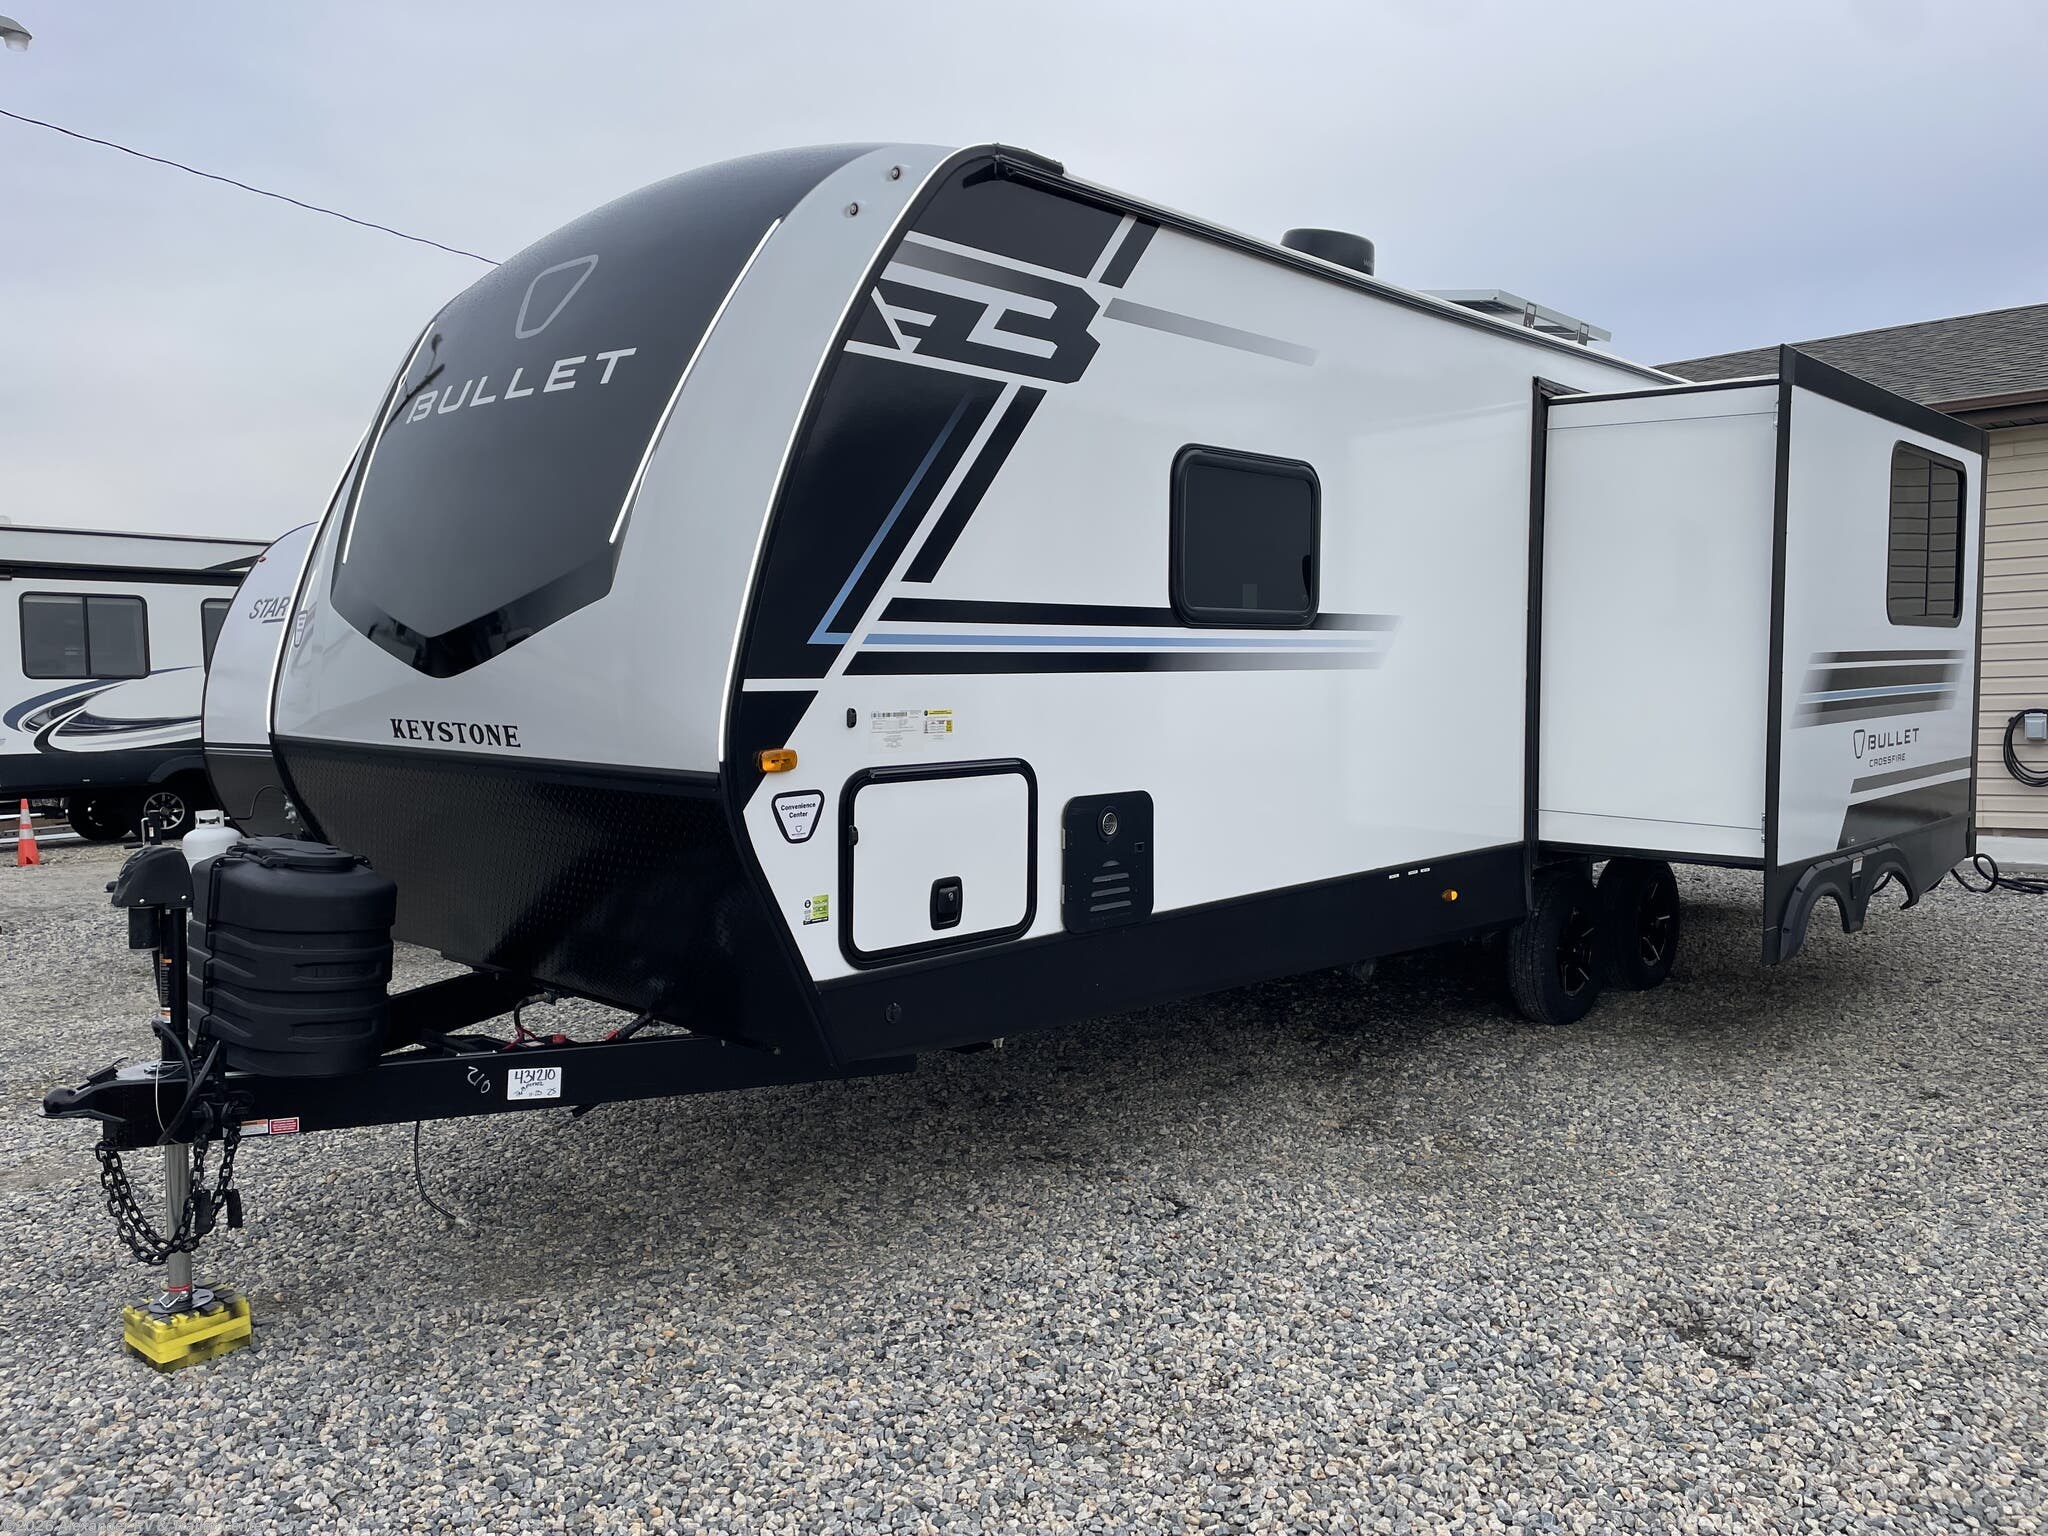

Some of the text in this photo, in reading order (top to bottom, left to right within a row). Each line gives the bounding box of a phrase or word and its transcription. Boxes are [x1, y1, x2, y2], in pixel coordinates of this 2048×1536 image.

[406, 347, 637, 425] BULLET
[390, 718, 521, 748] KEYSTONE
[1868, 727, 1920, 751] BULLET
[1869, 752, 1906, 768] CROSSFIRE
[781, 802, 816, 811] Convenience
[467, 1065, 491, 1094] 210
[514, 1068, 556, 1083] 431210
